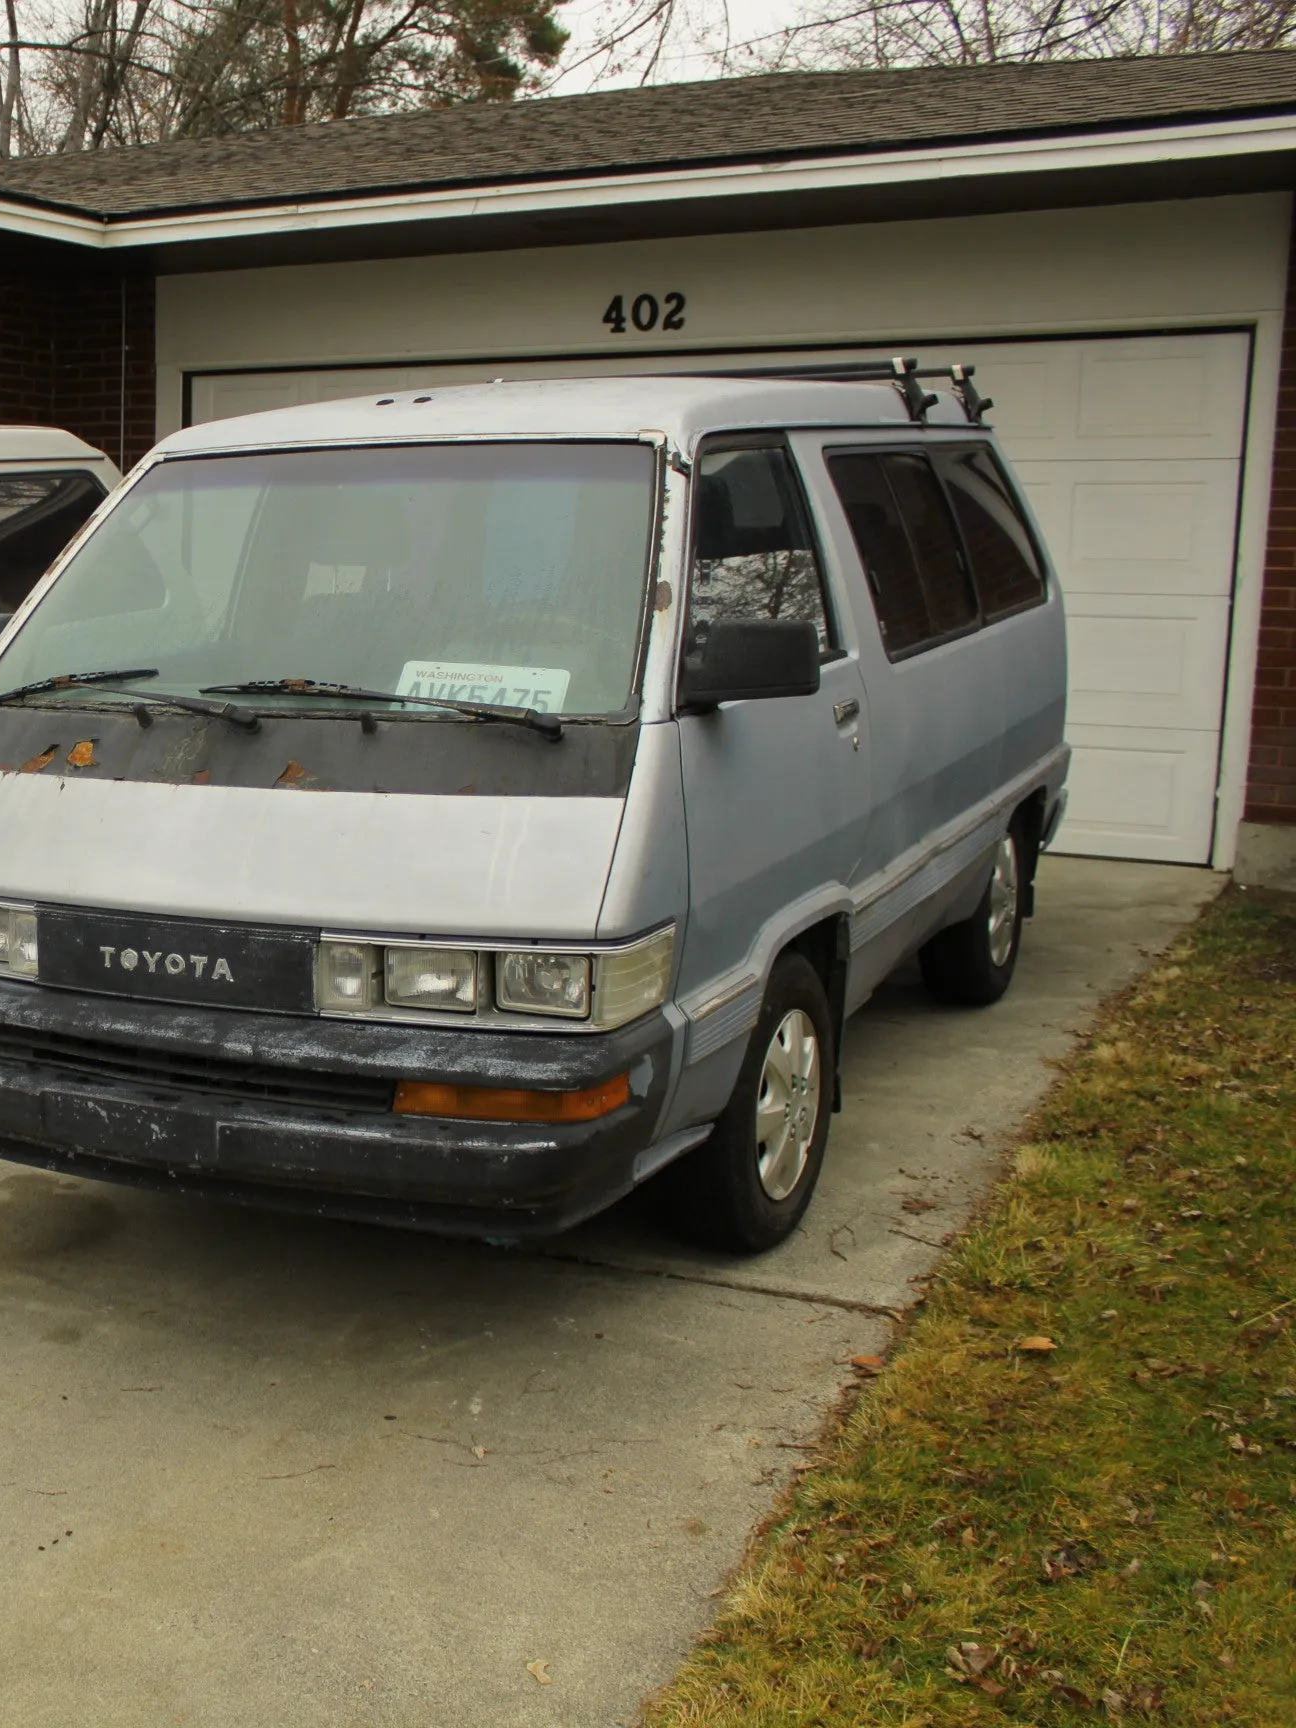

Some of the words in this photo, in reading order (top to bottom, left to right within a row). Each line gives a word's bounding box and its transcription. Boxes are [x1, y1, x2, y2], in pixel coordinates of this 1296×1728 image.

[602, 292, 685, 333] 402
[415, 670, 503, 684] WASHINGTON
[99, 946, 234, 982] TOYOTA
